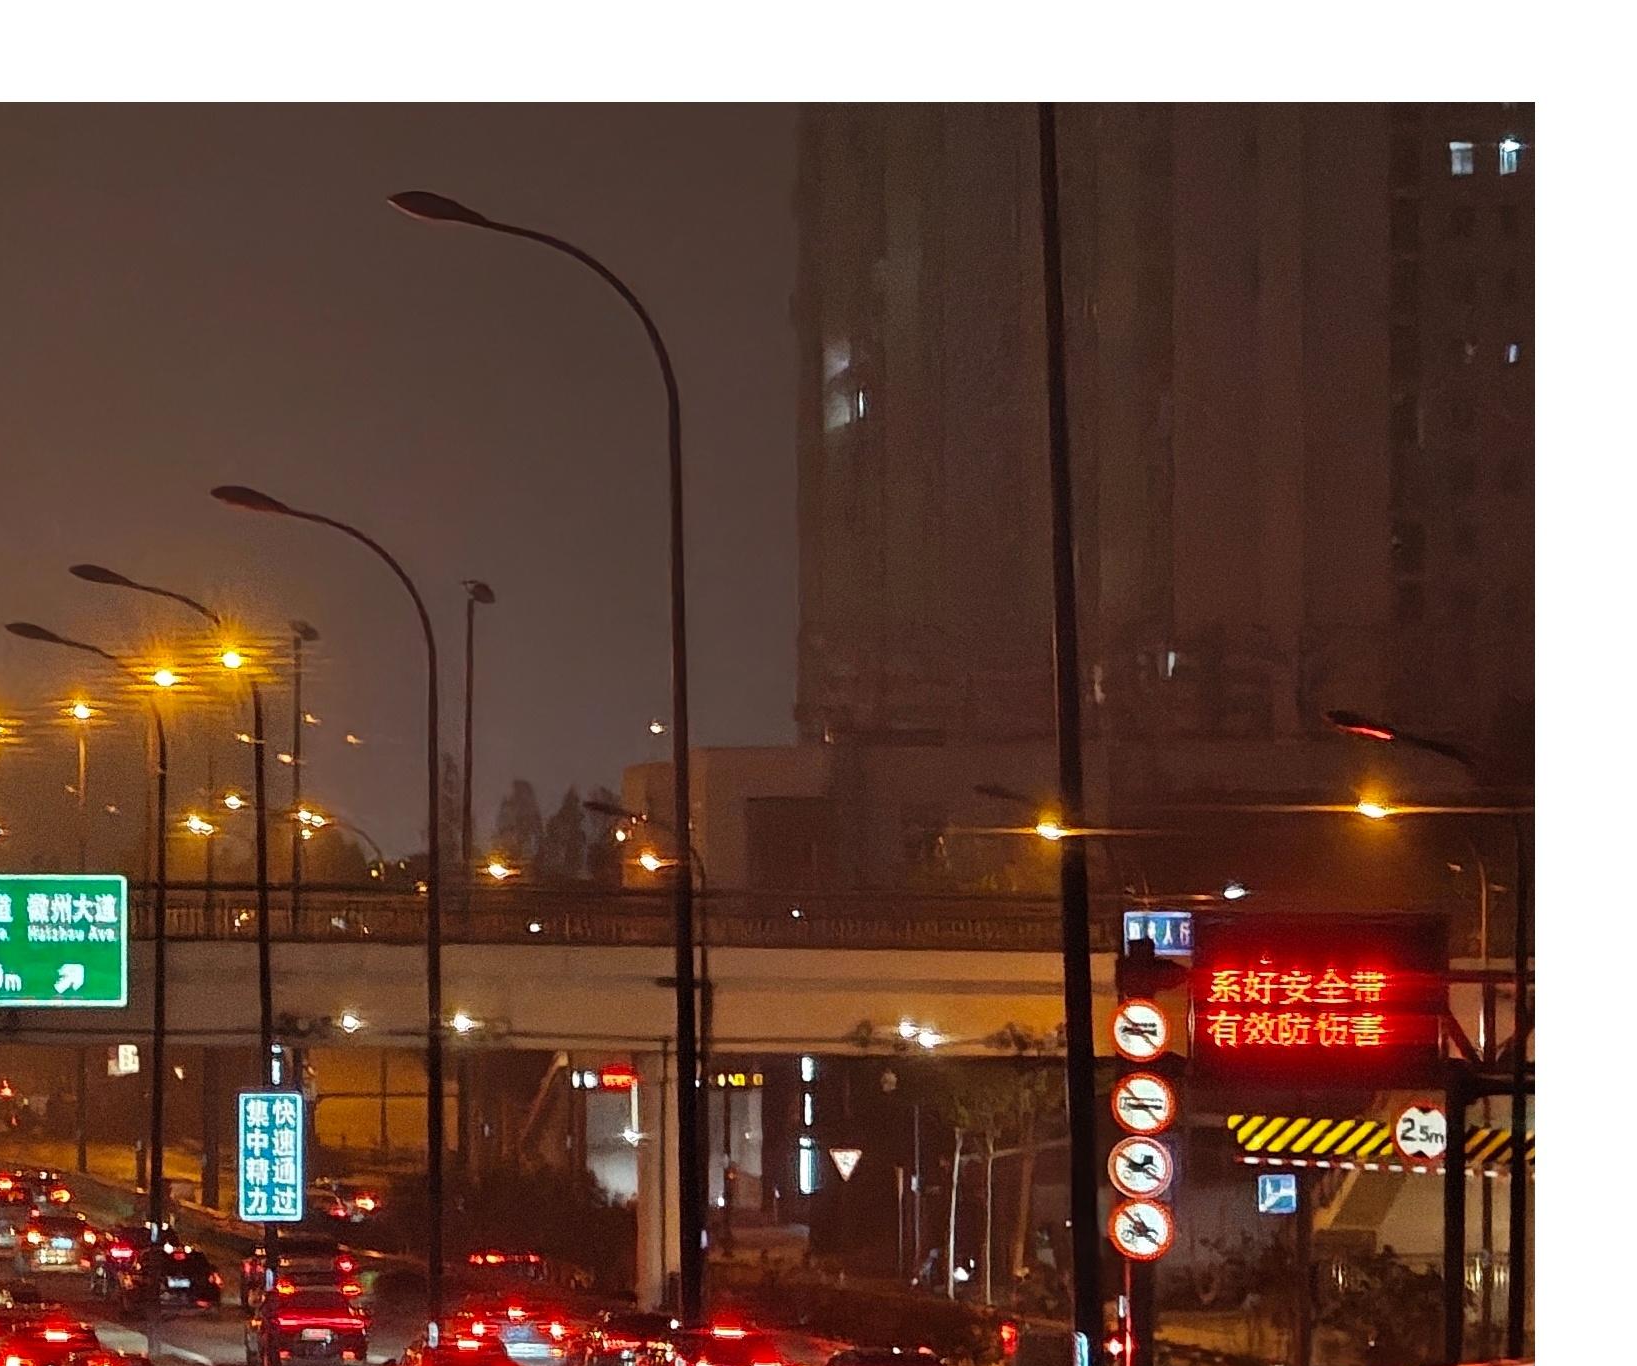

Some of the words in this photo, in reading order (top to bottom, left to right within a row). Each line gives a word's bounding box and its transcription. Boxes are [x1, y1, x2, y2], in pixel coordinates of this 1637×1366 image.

[27, 892, 118, 923] 徽州大道
[1207, 969, 1386, 1005] 系好安全带
[1207, 1010, 1387, 1047] 有效防伤害
[246, 1098, 270, 1215] 集中精力
[272, 1098, 296, 1215] 快速通过
